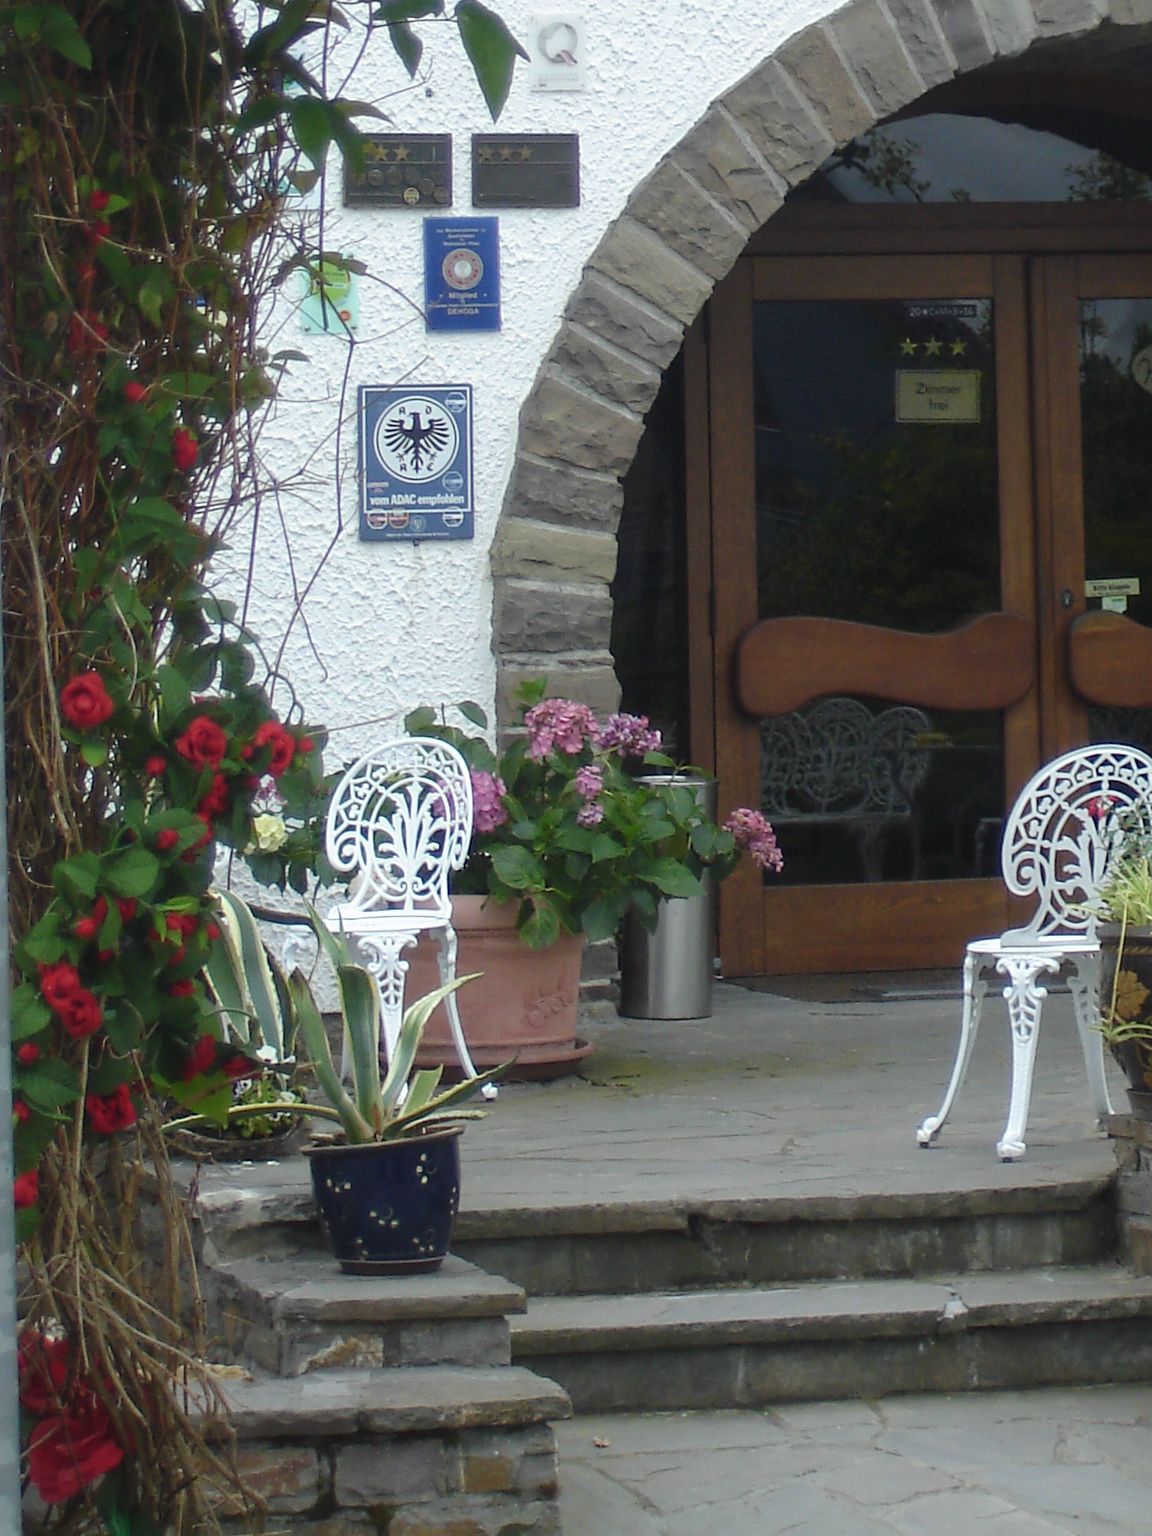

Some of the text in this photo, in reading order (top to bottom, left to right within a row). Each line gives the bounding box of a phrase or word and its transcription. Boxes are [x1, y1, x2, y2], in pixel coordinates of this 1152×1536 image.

[447, 308, 480, 316] DEHOGA
[916, 382, 962, 395] Zimmer
[369, 493, 465, 507] vom ADAC empfohlen
